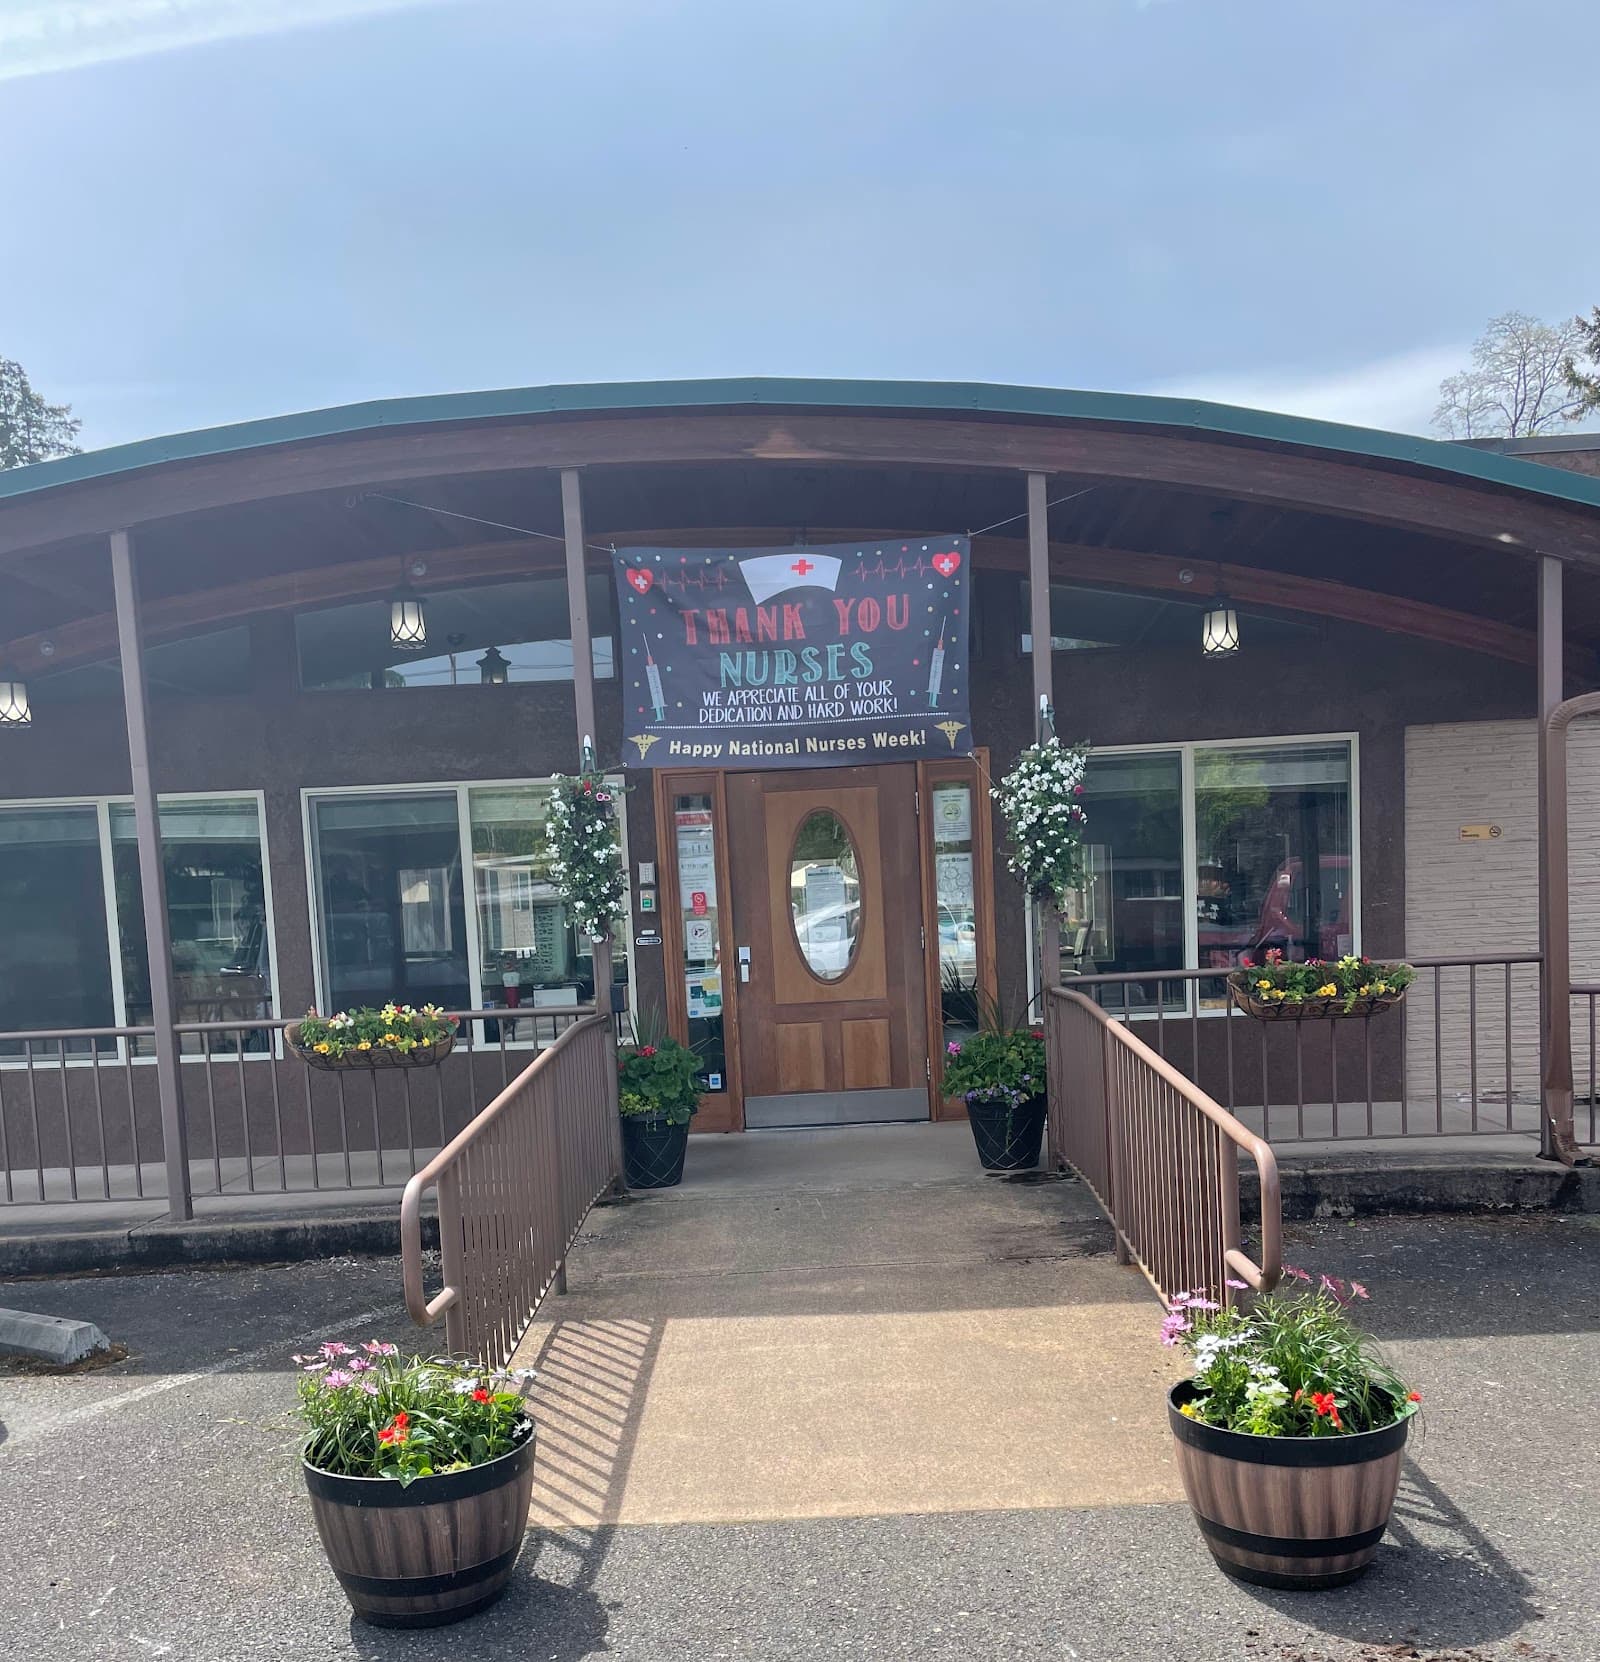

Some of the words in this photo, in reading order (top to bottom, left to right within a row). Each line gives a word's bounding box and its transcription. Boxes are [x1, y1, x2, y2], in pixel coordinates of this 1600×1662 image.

[679, 604, 806, 646] THANK
[832, 594, 910, 636] YOU
[719, 642, 875, 688] NURSES
[702, 691, 725, 707] WE
[727, 687, 800, 706] APPRECIATE
[804, 685, 829, 701] ALL
[834, 683, 851, 700] OF
[855, 680, 894, 697] YOUR
[699, 706, 773, 724] DEDICATION
[776, 704, 803, 721] AND
[808, 701, 845, 718] HARD
[850, 698, 898, 715] WORK!
[669, 740, 722, 758] Happy
[728, 736, 800, 755] National
[806, 733, 867, 751] Nurses
[872, 729, 927, 747] Week!
